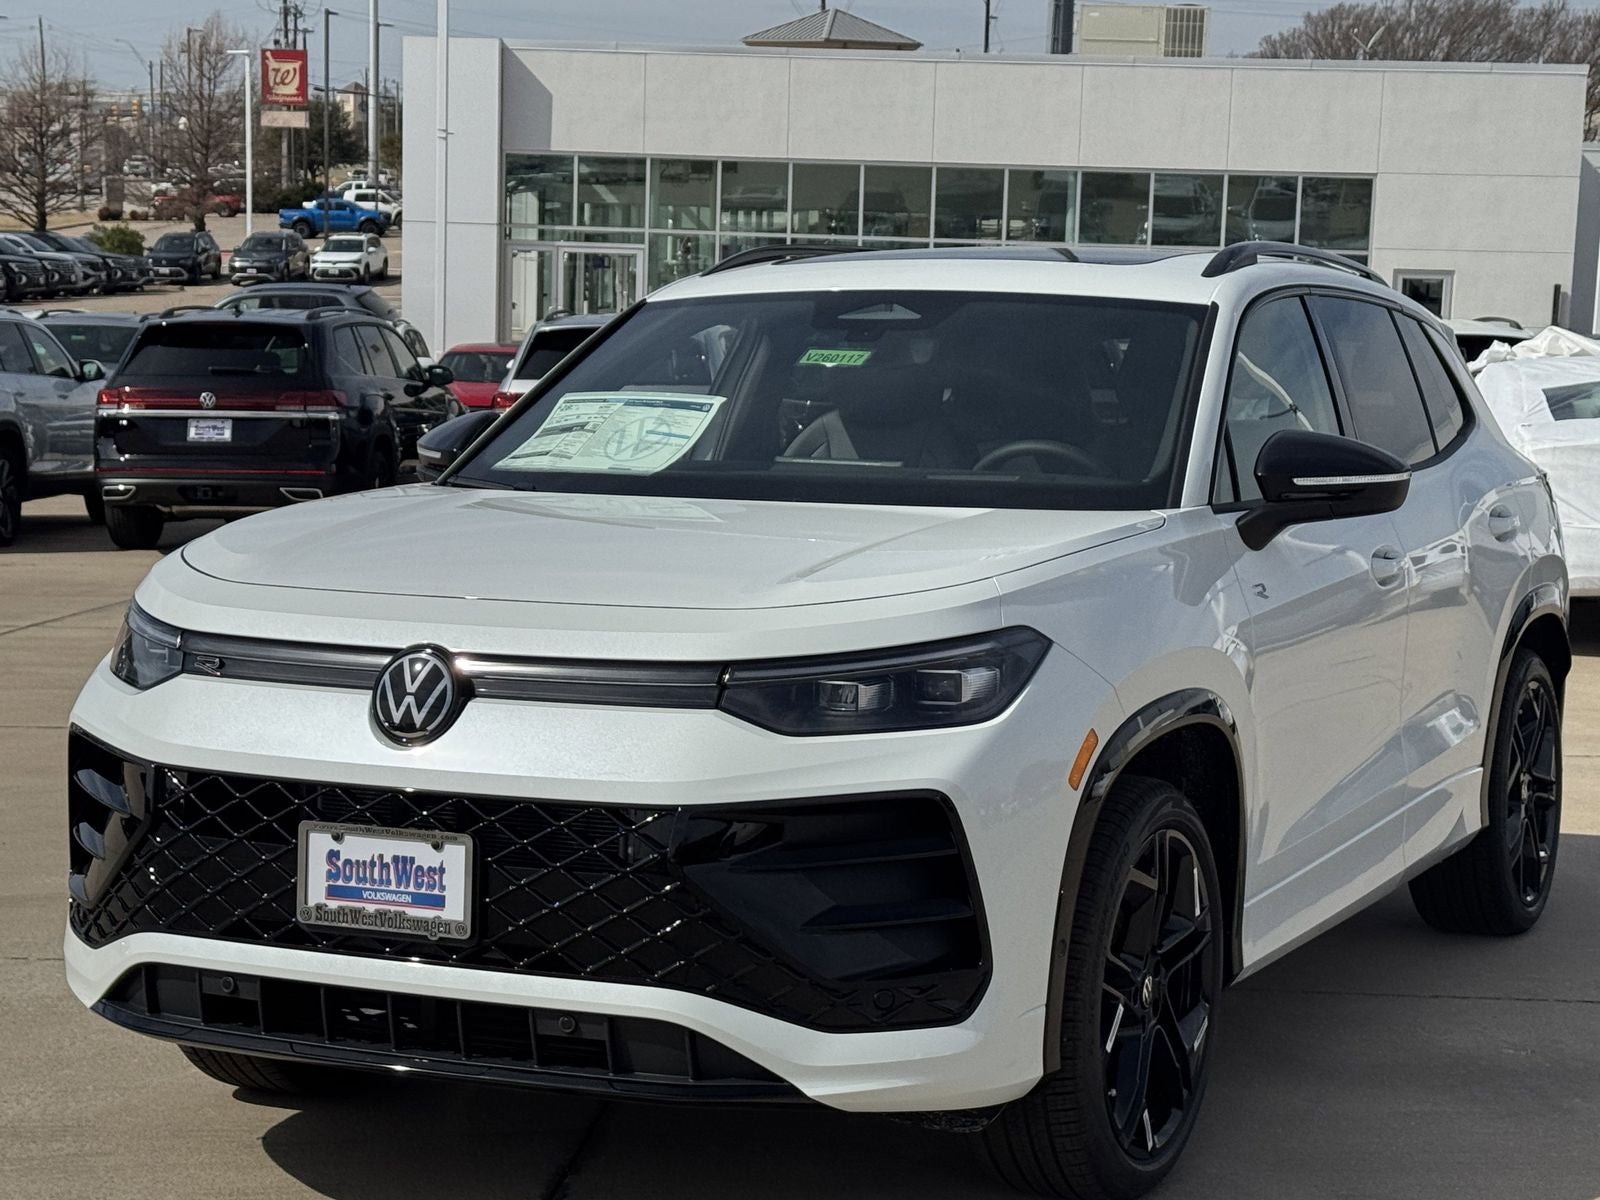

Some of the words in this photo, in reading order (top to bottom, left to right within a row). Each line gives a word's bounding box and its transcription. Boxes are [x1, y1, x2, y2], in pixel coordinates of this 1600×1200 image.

[806, 352, 865, 364] V260117
[377, 654, 453, 737] VW
[325, 848, 447, 891] SouthWest
[362, 890, 412, 904] VOLKSWAGEN
[315, 904, 451, 937] SouthWestVolkswagen
